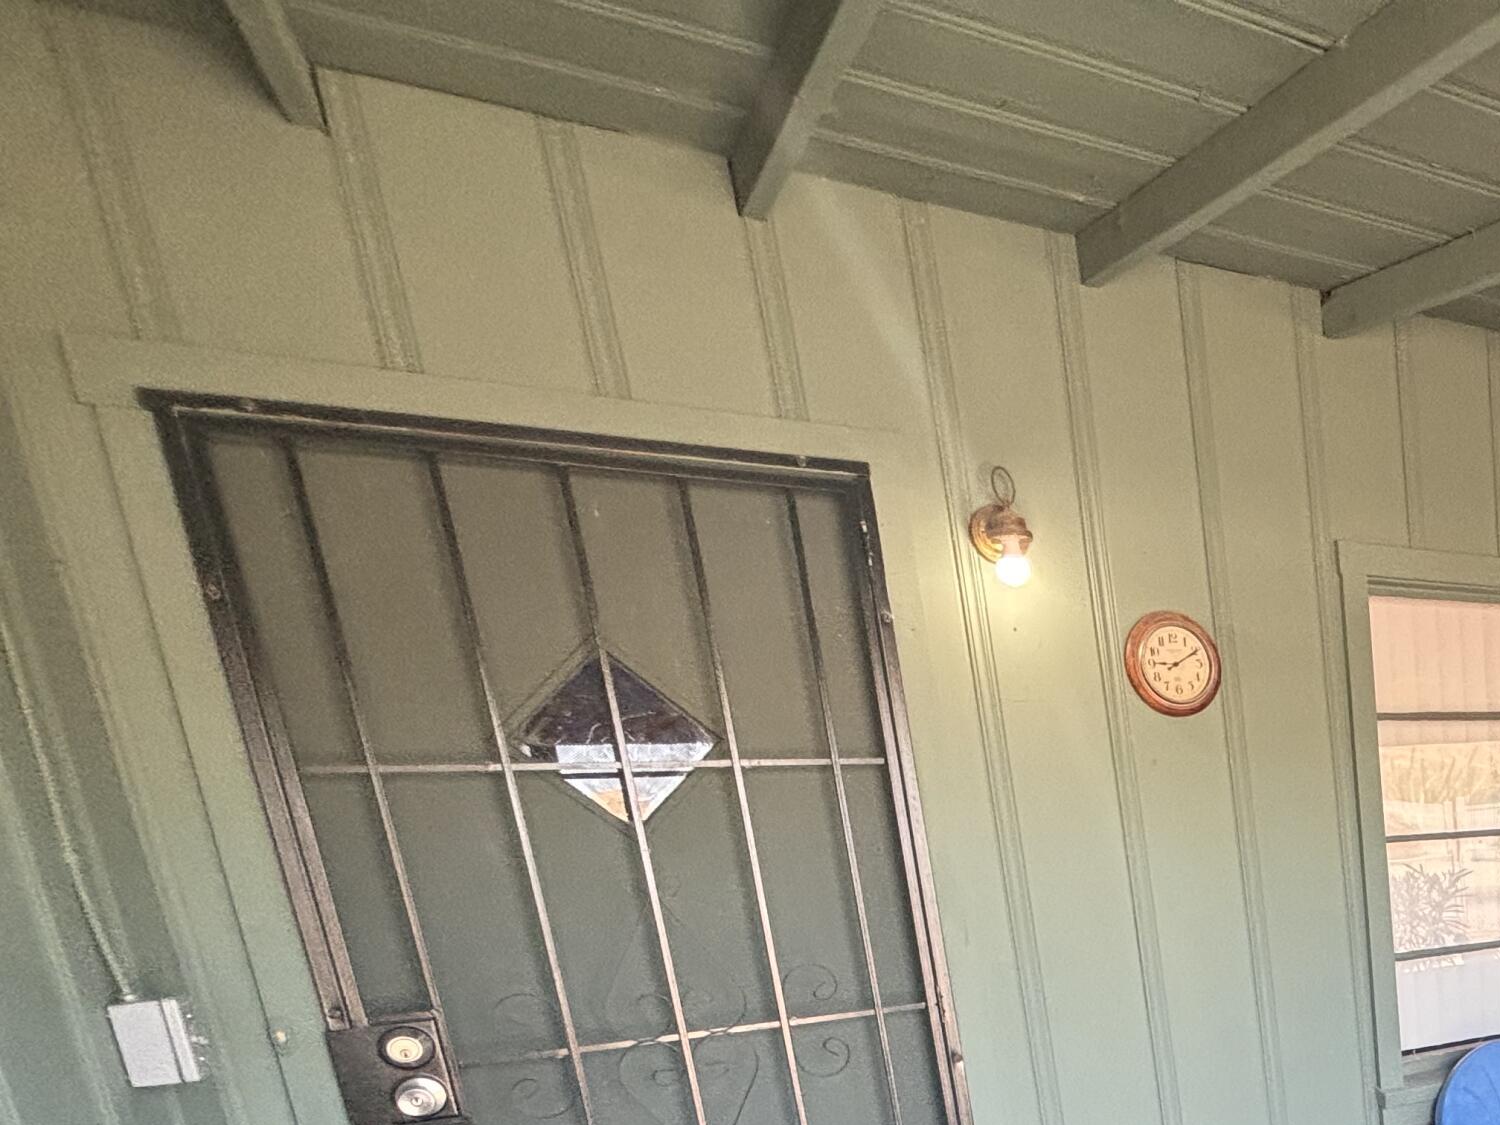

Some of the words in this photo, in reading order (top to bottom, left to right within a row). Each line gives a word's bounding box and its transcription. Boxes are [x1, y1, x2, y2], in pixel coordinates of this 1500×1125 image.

[668, 587, 897, 699] hello
[1168, 633, 1178, 643] 12
[1164, 681, 1170, 691] 7
[1175, 684, 1183, 695] 6
